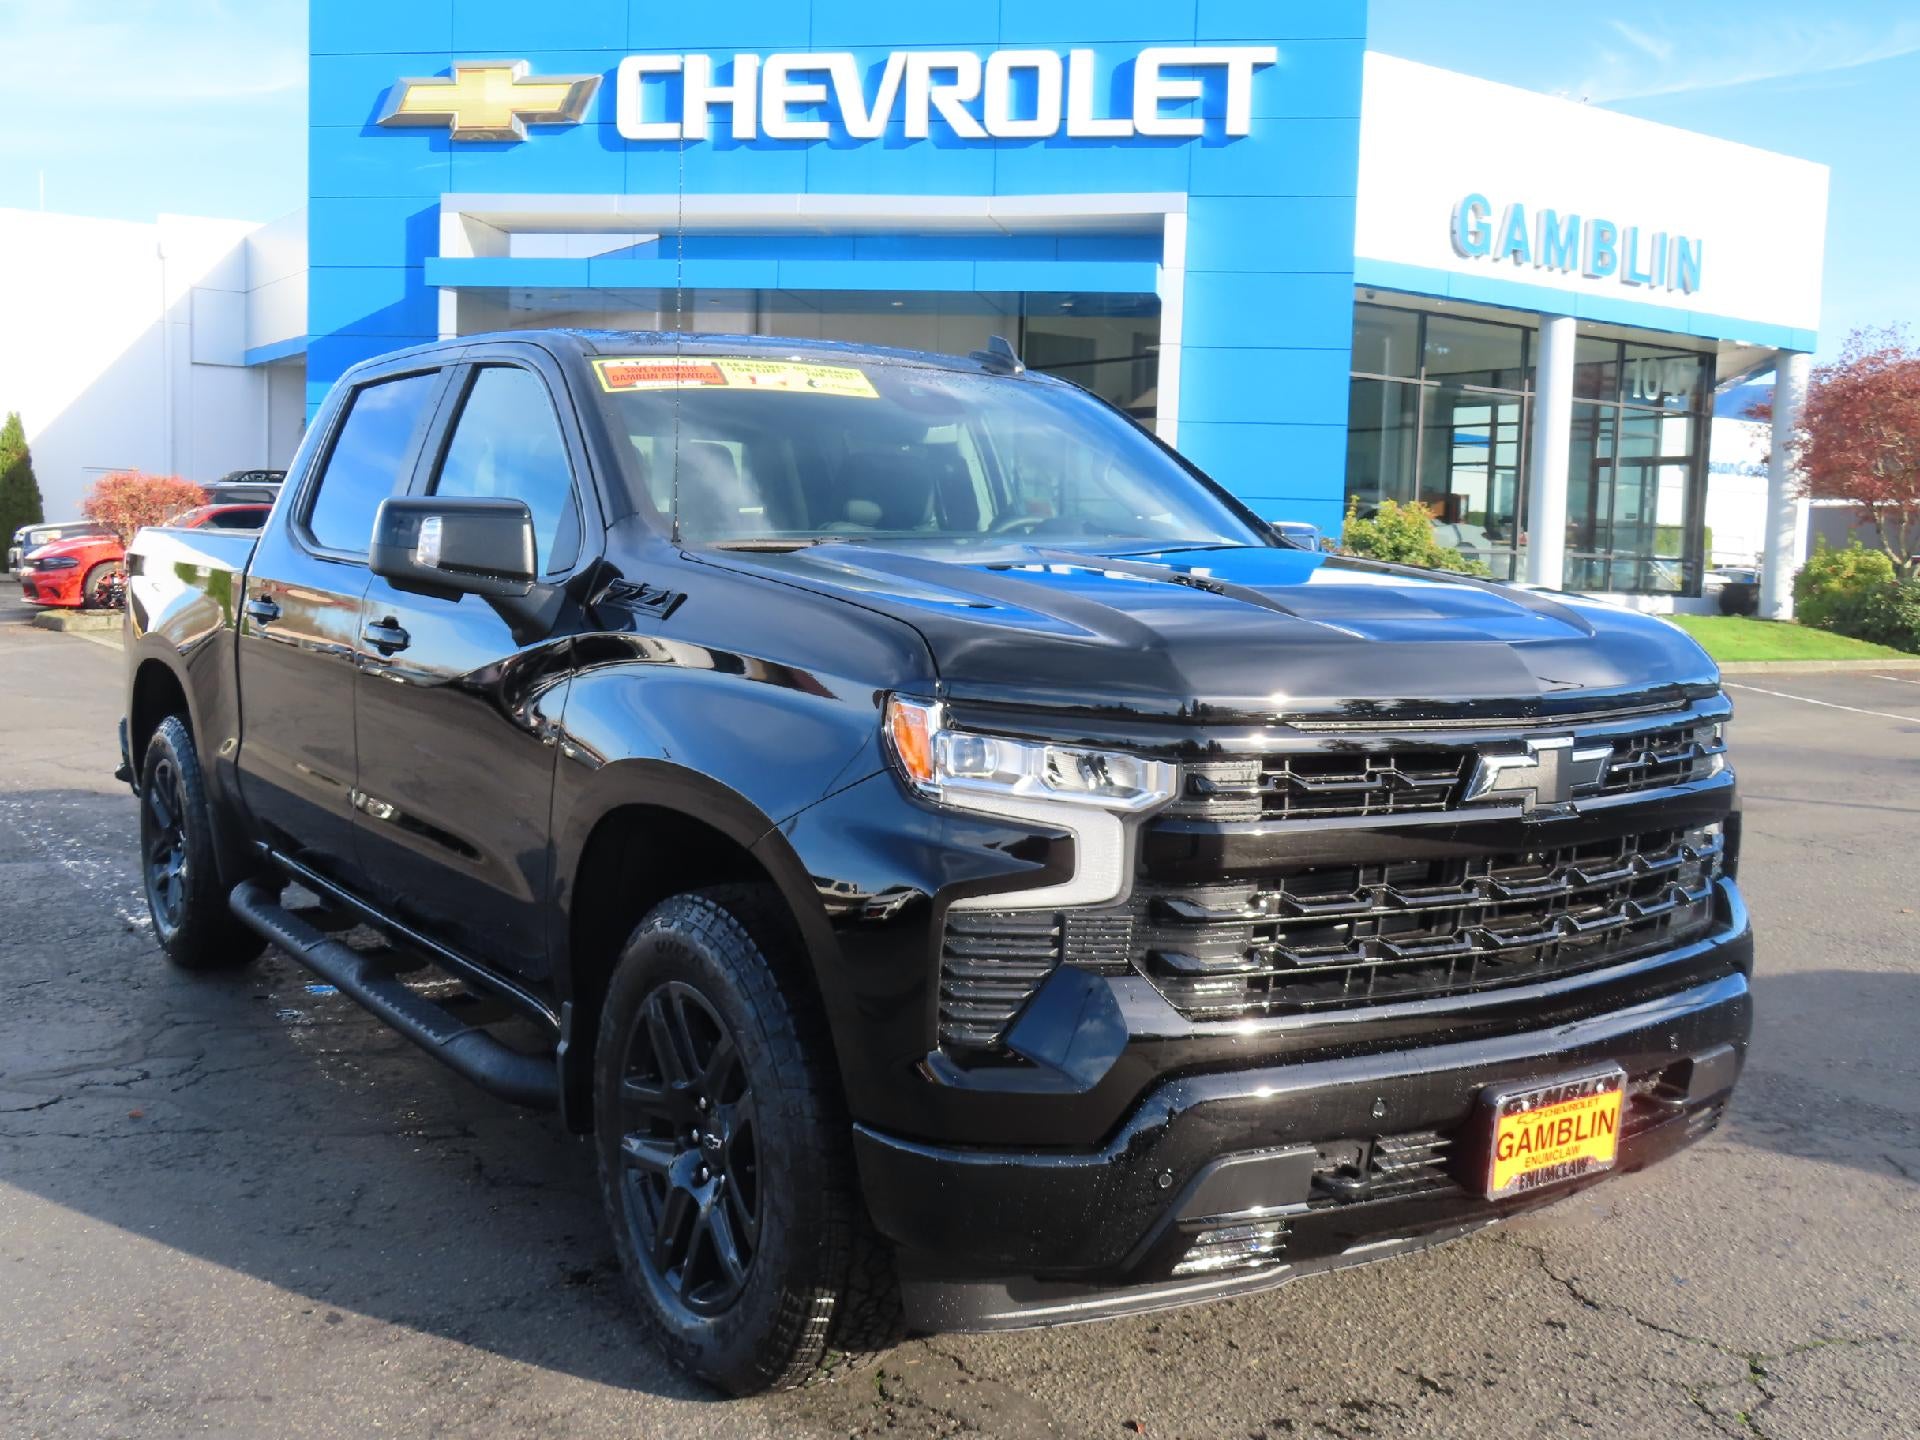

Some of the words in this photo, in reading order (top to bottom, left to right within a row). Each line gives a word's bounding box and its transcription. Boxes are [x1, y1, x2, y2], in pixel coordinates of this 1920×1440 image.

[615, 46, 1278, 141] CHEVROLET
[1450, 193, 1702, 294] GAMBLIN
[1495, 1107, 1616, 1162] GAMBLIN
[1544, 1097, 1601, 1118] CHEVROLET
[1524, 1145, 1581, 1168] ENUMCLAW
